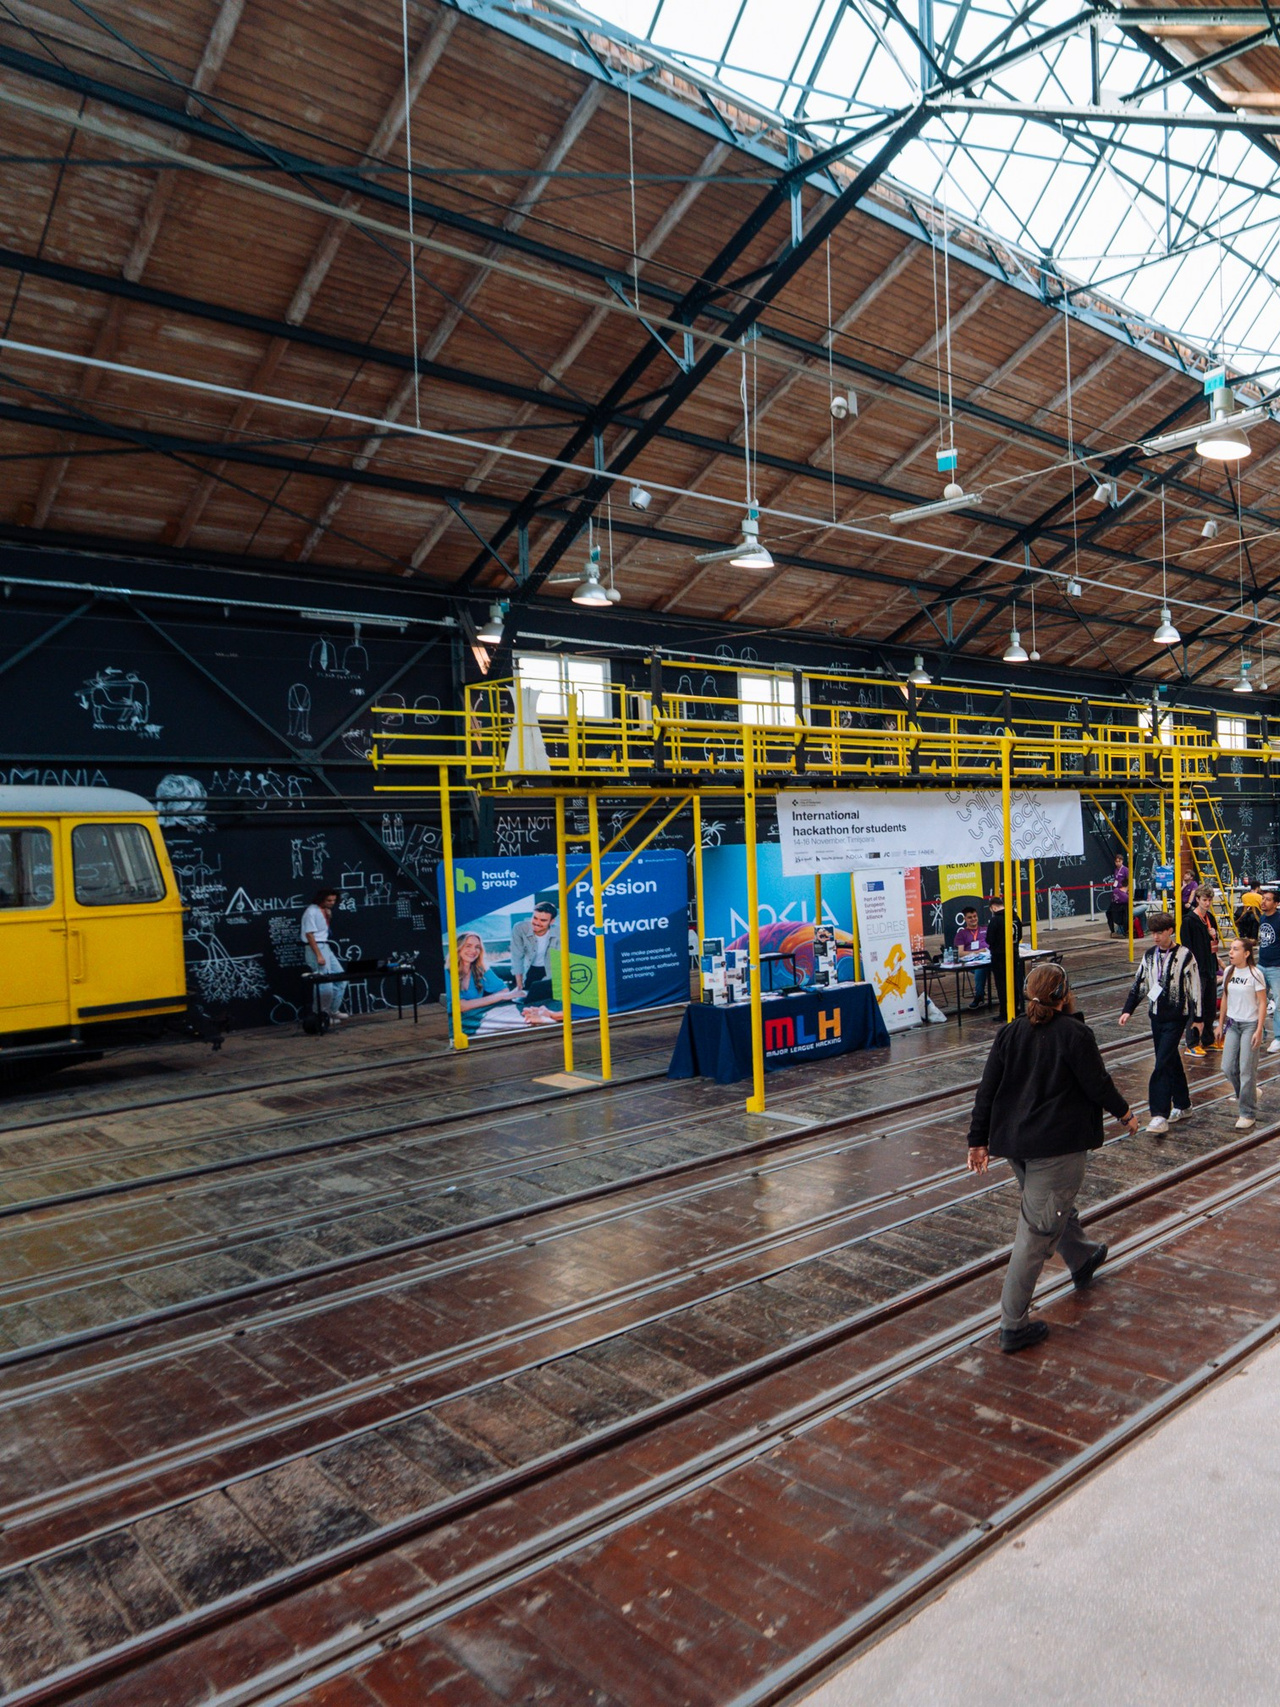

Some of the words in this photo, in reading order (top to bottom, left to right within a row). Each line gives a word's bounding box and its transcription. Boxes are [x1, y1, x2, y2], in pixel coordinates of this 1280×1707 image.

[792, 810, 860, 821] International
[498, 816, 522, 830] AM
[527, 816, 555, 830] NOT
[793, 826, 849, 836] hackathon
[851, 825, 864, 834] for
[866, 823, 907, 833] students
[494, 829, 539, 843] XOTIC
[481, 870, 520, 880] haufe.
[946, 871, 976, 883] premium
[481, 879, 518, 890] group
[947, 881, 977, 892] software
[576, 916, 669, 938] software
[866, 921, 906, 936] EUDRES
[1229, 976, 1248, 985] ARNI
[764, 1007, 842, 1051] MLH
[766, 1048, 788, 1058] MAJOR
[790, 1043, 814, 1053] LEAGUE
[815, 1037, 842, 1048] HACKING
